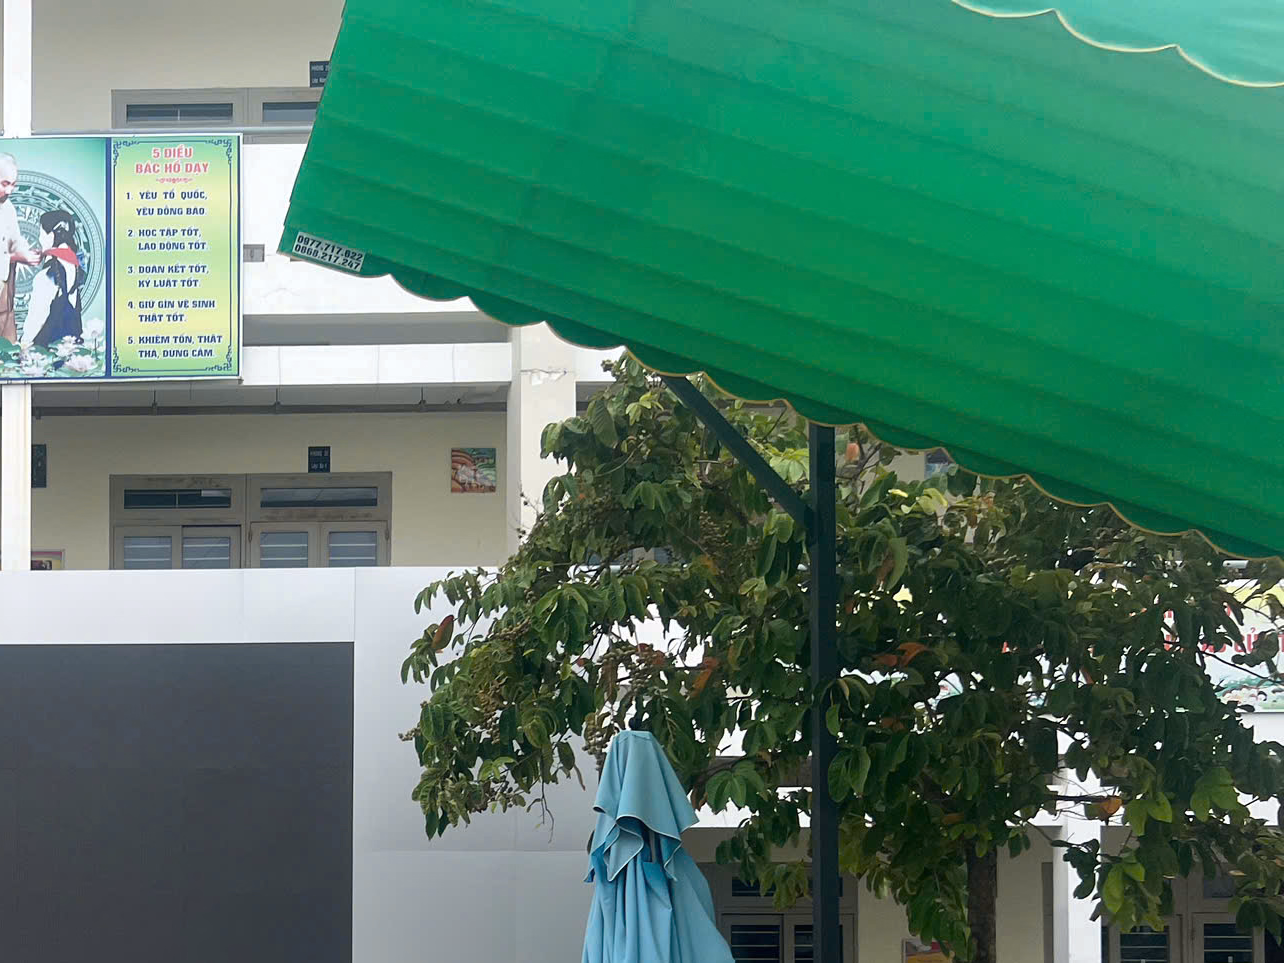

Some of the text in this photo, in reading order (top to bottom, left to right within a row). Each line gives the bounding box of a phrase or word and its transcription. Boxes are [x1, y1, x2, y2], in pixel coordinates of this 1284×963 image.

[152, 148, 160, 158] 5
[135, 160, 209, 175] BÁC HỒ DẠY
[126, 191, 134, 200] 1.
[139, 191, 158, 200] YÊU
[162, 188, 175, 200] TỔ
[136, 207, 155, 216] YÊU
[157, 205, 183, 216] ĐỒNG
[138, 228, 157, 238] HỌC
[159, 227, 179, 238] TẬP
[138, 242, 157, 251] LAO
[159, 241, 185, 252] ĐỘNG
[127, 265, 136, 274] 3.
[138, 264, 165, 274] ĐOÀN
[167, 263, 186, 274] KẾT
[138, 278, 151, 288] KỶ
[153, 278, 179, 288] LUẬT
[127, 299, 216, 310] 4. GIỮ GÌN VỆ SINH
[138, 312, 164, 324] THẬT
[127, 335, 136, 345] 5.
[138, 334, 170, 345] KHIÊM
[197, 334, 223, 345] THẬT
[162, 347, 189, 358] DŨNG
